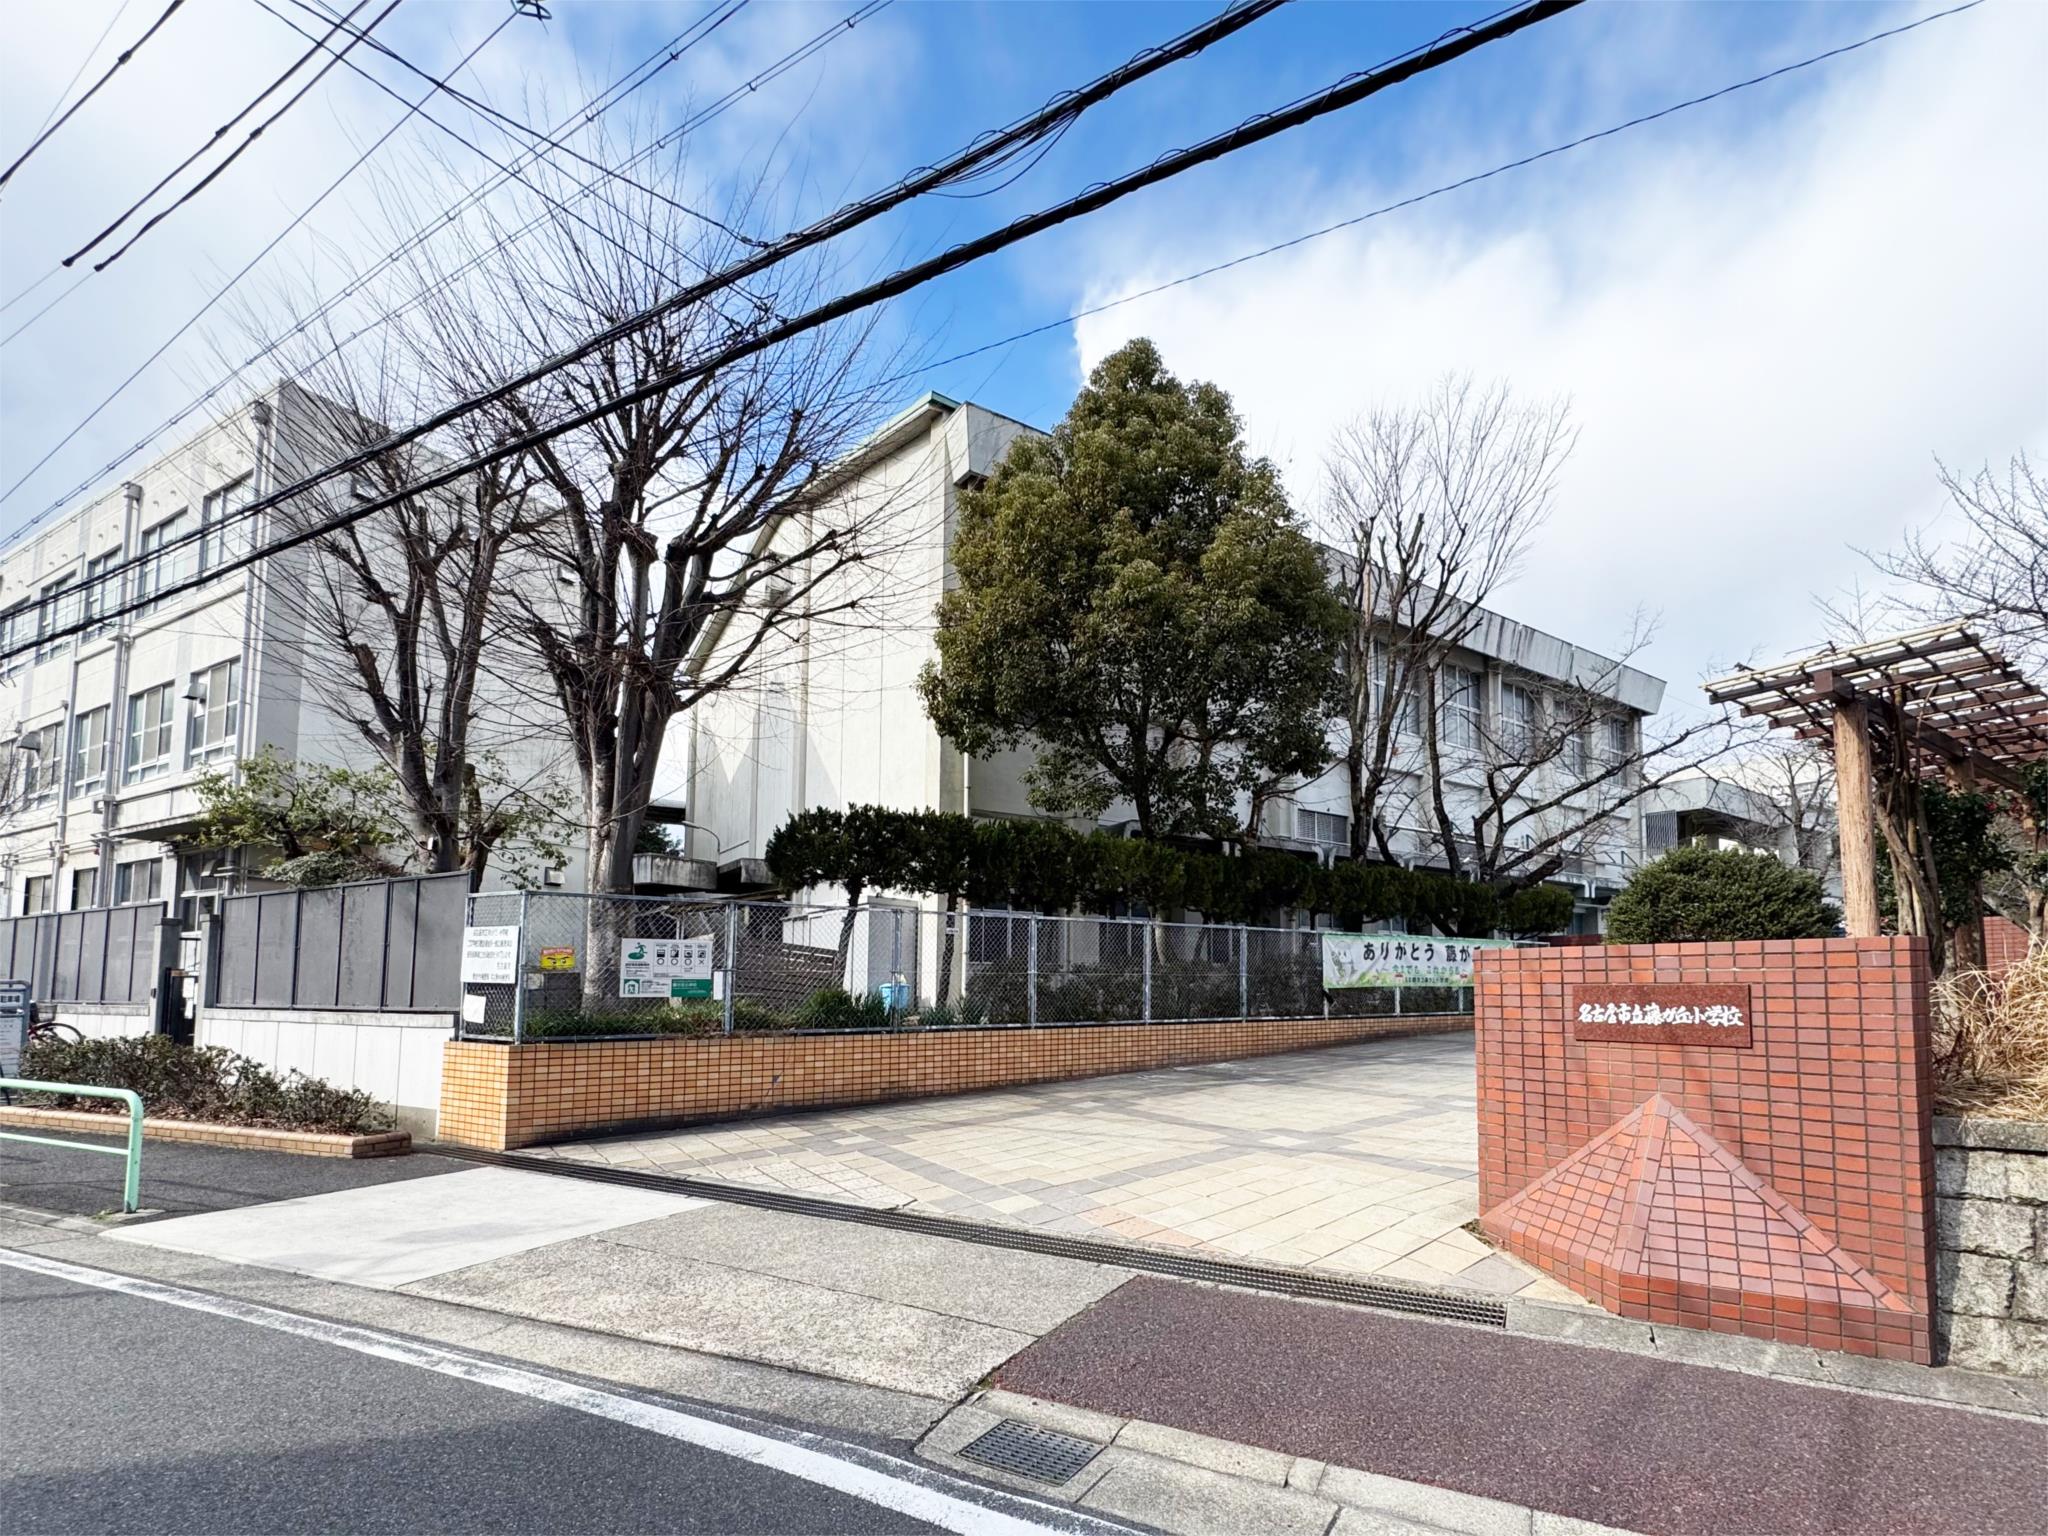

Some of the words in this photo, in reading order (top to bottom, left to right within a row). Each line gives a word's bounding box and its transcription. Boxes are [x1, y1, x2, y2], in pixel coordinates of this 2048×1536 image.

[1363, 942, 1435, 962] ありがとう
[1445, 944, 1481, 963] 藤が
